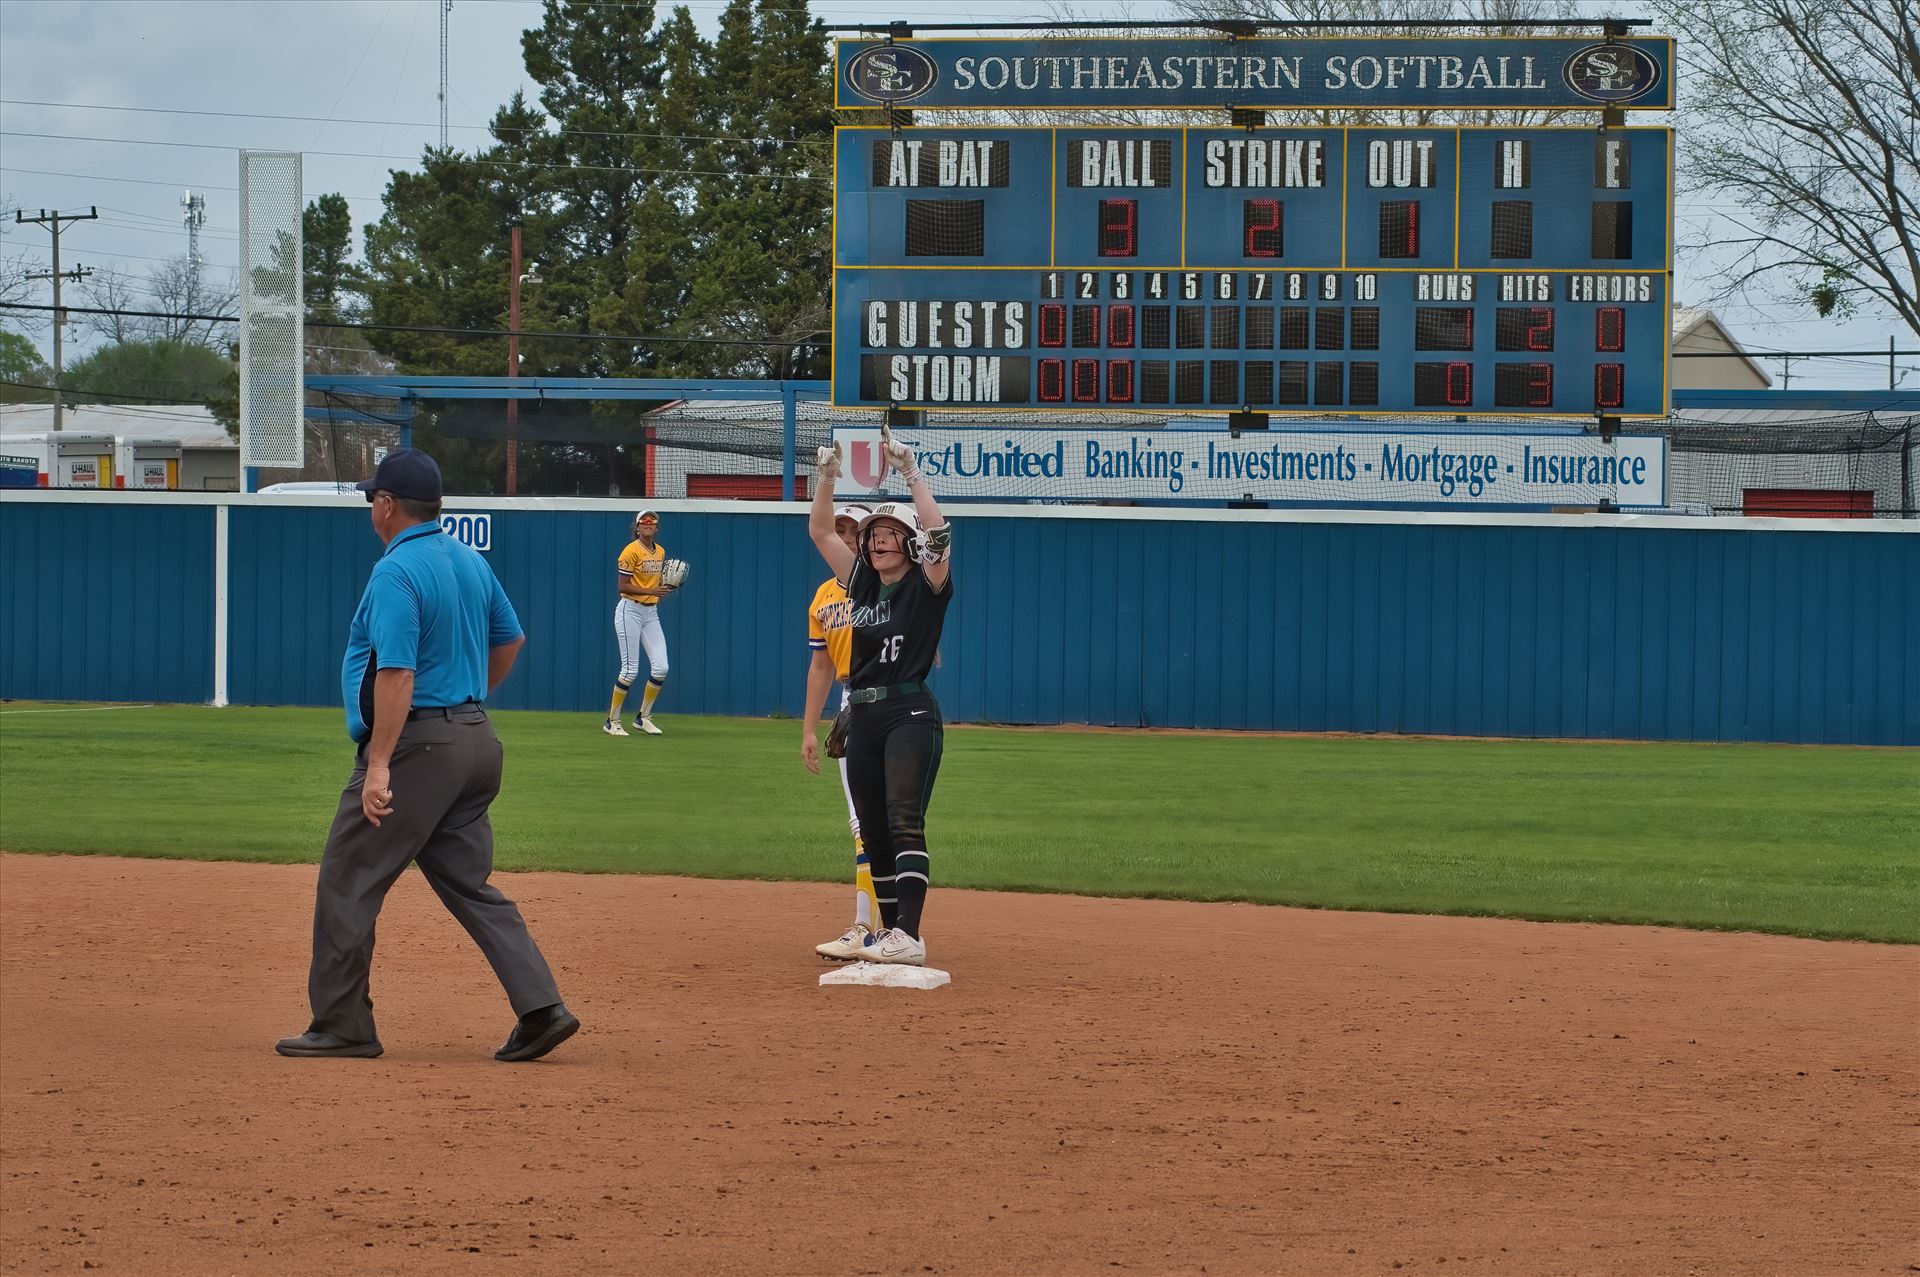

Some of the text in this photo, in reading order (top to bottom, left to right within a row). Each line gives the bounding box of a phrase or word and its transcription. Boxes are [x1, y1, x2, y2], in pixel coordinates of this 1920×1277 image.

[953, 55, 1546, 91] SOUTHEASTERN SOFTBALL
[889, 140, 993, 187] AT BAT
[1082, 140, 1155, 187] BALL
[1205, 140, 1322, 188] STRIKE
[1369, 140, 1433, 188] OUT
[1503, 140, 1521, 188] H
[1606, 140, 1620, 188] E
[1104, 200, 1134, 256] 3
[1248, 199, 1279, 256] 2
[1408, 203, 1416, 254] 1
[1048, 273, 1375, 299] 1 2 3 4 5 6 7 8 9 10
[1418, 274, 1473, 300] RUNS
[1503, 275, 1549, 300] HITS
[1571, 275, 1650, 301] ERRORS
[868, 301, 1024, 348] GUESTS
[1040, 304, 1065, 346] 0
[1109, 304, 1133, 346] 0
[1528, 308, 1552, 349] 2
[1599, 308, 1622, 350] 0
[890, 355, 1000, 402] STORM
[1039, 359, 1133, 401] 0 0 0
[1447, 362, 1470, 404] 0
[1529, 363, 1552, 405] 3
[1598, 363, 1621, 406] 0
[72, 464, 95, 473] U-HAUL
[144, 467, 164, 476] U-HAUL
[1086, 437, 1184, 493] Banking
[1208, 437, 1356, 481] Investments
[1381, 443, 1497, 497] Mortgage
[1524, 445, 1646, 486] Insurance
[443, 516, 488, 548] 200
[879, 635, 904, 663] 16
